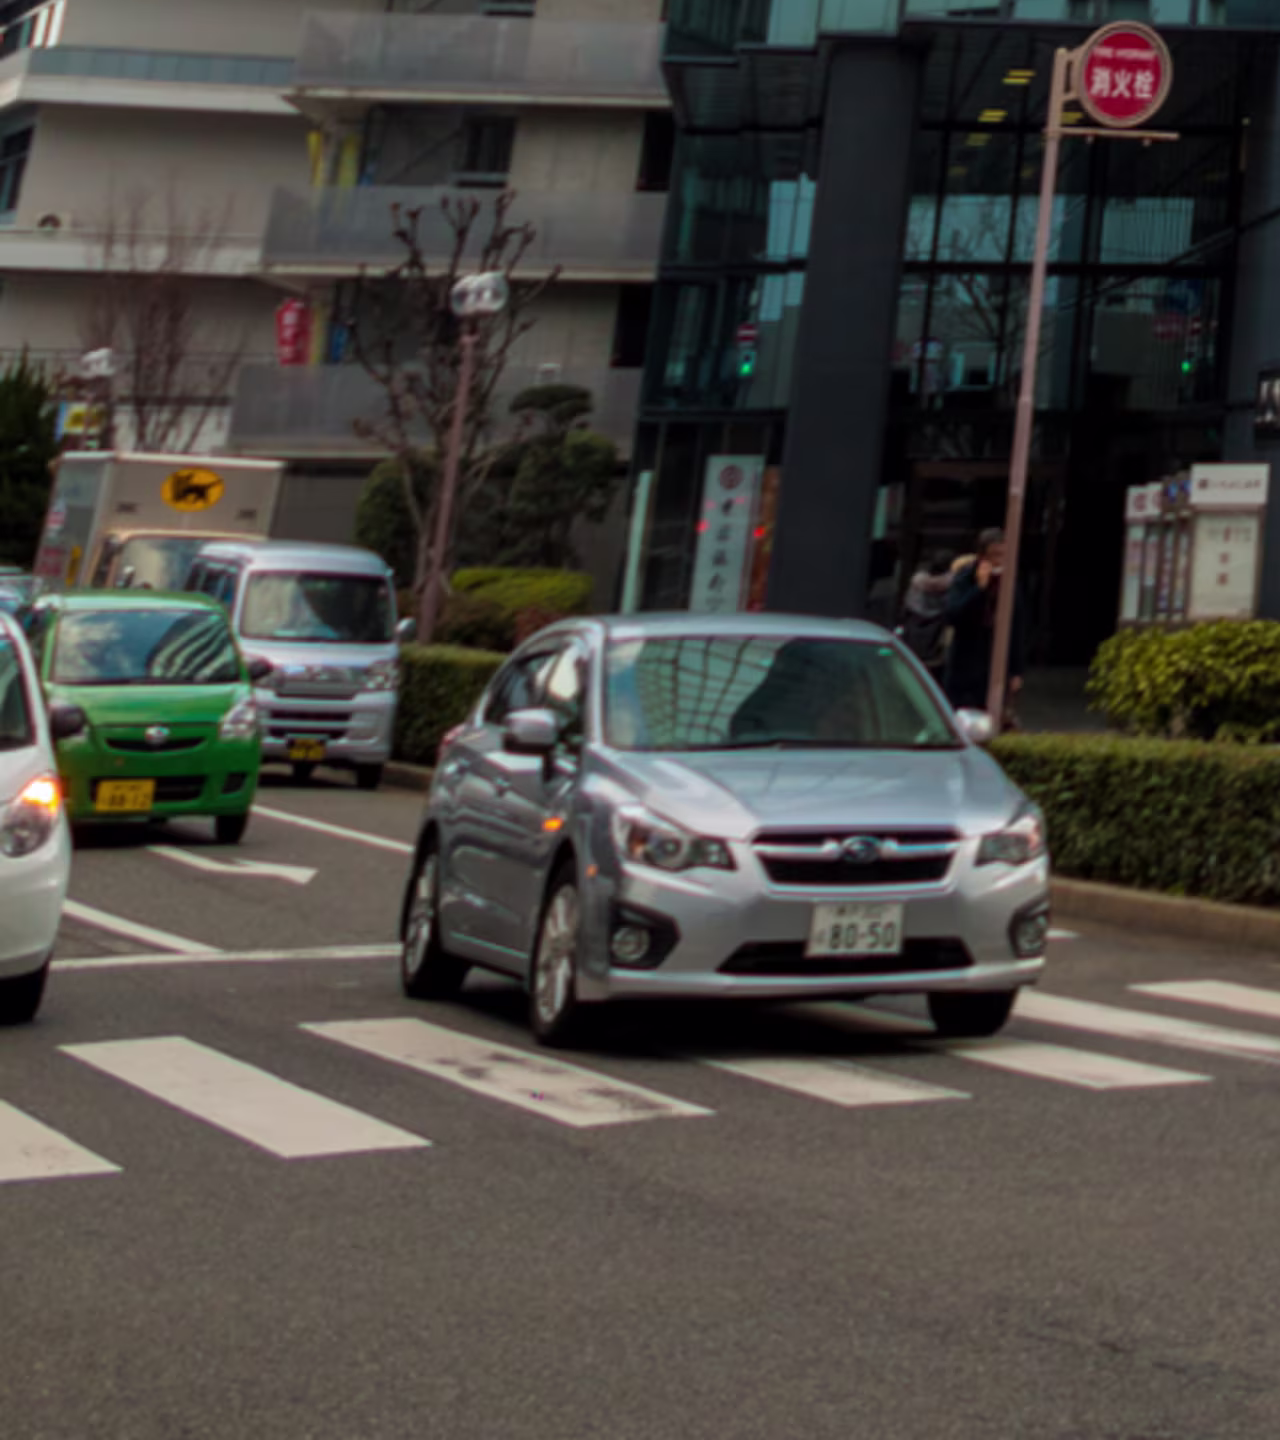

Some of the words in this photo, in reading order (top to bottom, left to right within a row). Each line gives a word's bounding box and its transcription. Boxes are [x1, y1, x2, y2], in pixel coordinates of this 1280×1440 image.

[1089, 66, 1154, 98] 消火栓
[830, 922, 895, 949] 80-50
